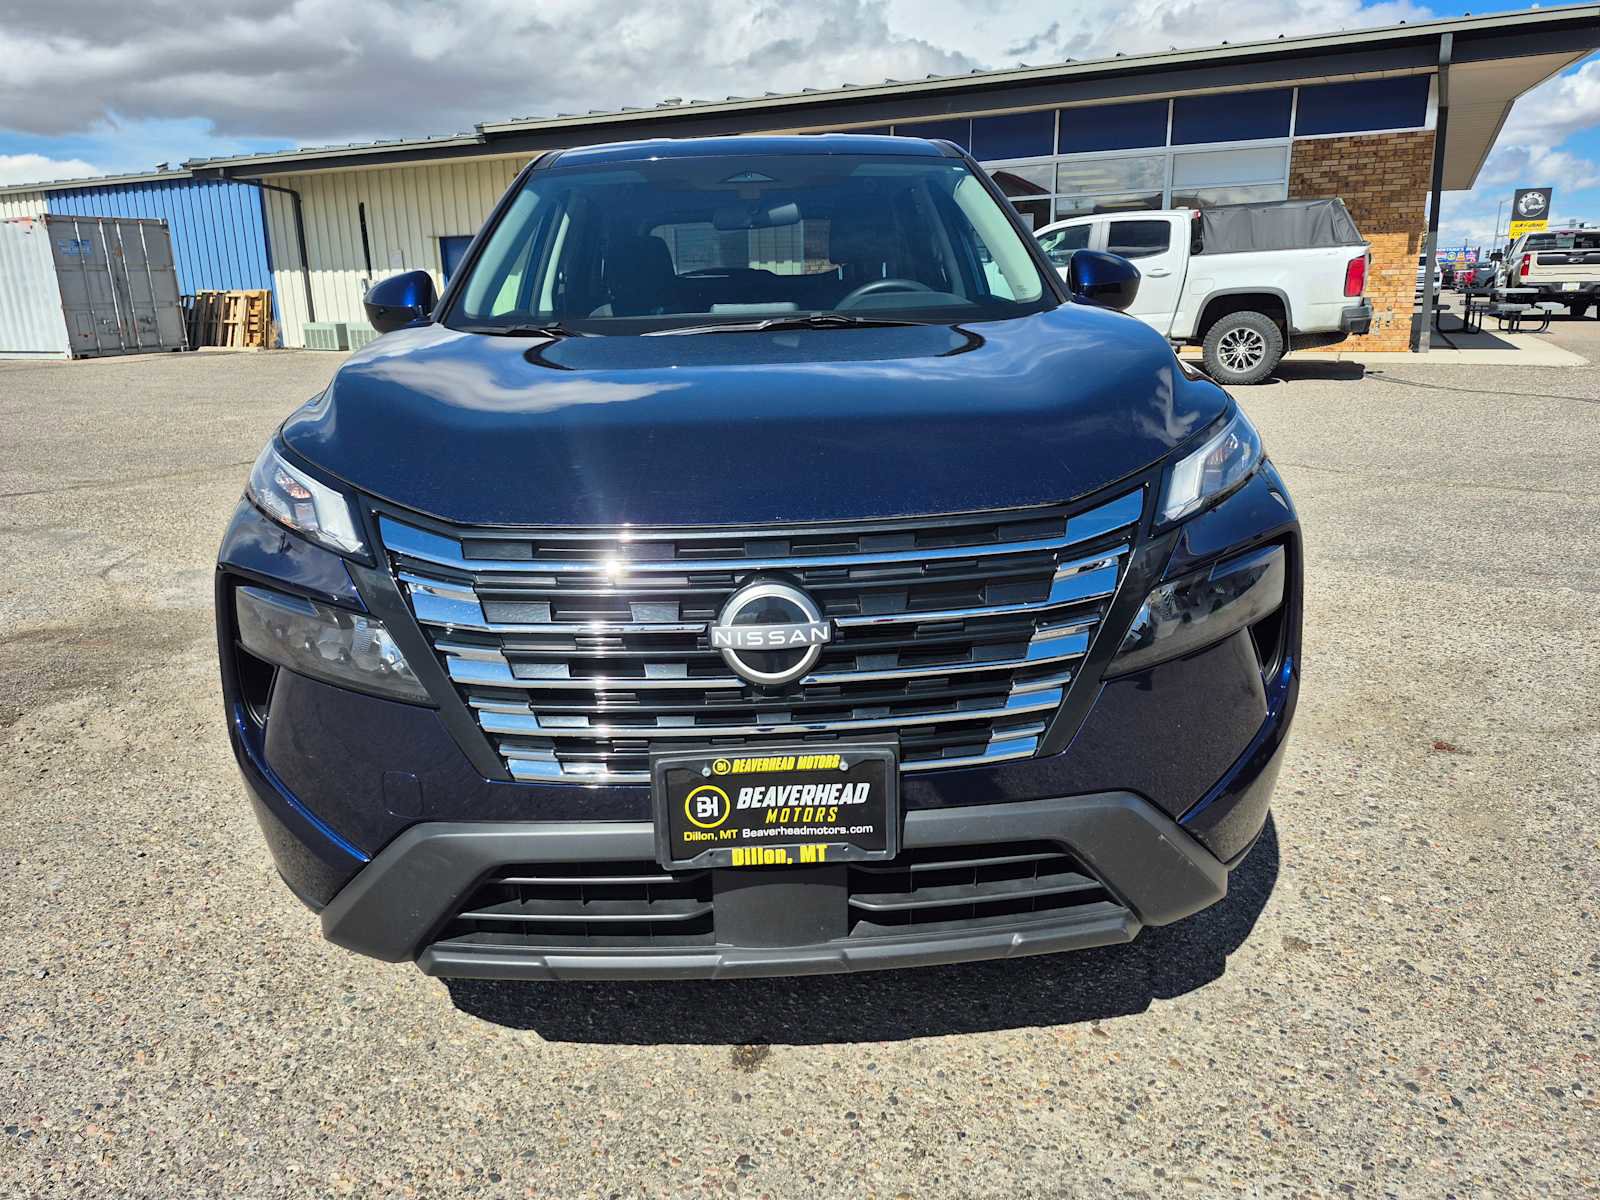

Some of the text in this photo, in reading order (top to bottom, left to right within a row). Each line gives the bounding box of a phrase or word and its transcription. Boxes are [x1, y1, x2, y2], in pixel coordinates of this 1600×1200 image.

[714, 626, 828, 646] NISSAN
[731, 756, 796, 773] BEAVERHEAD
[796, 754, 840, 770] MOTORS
[736, 782, 870, 809] BEAVERHEAD
[765, 806, 838, 823] MOTORS
[683, 829, 739, 841] Dillon, MT
[742, 824, 873, 838] Beaverheadmotors.com
[731, 843, 828, 866] Dillon, MT
